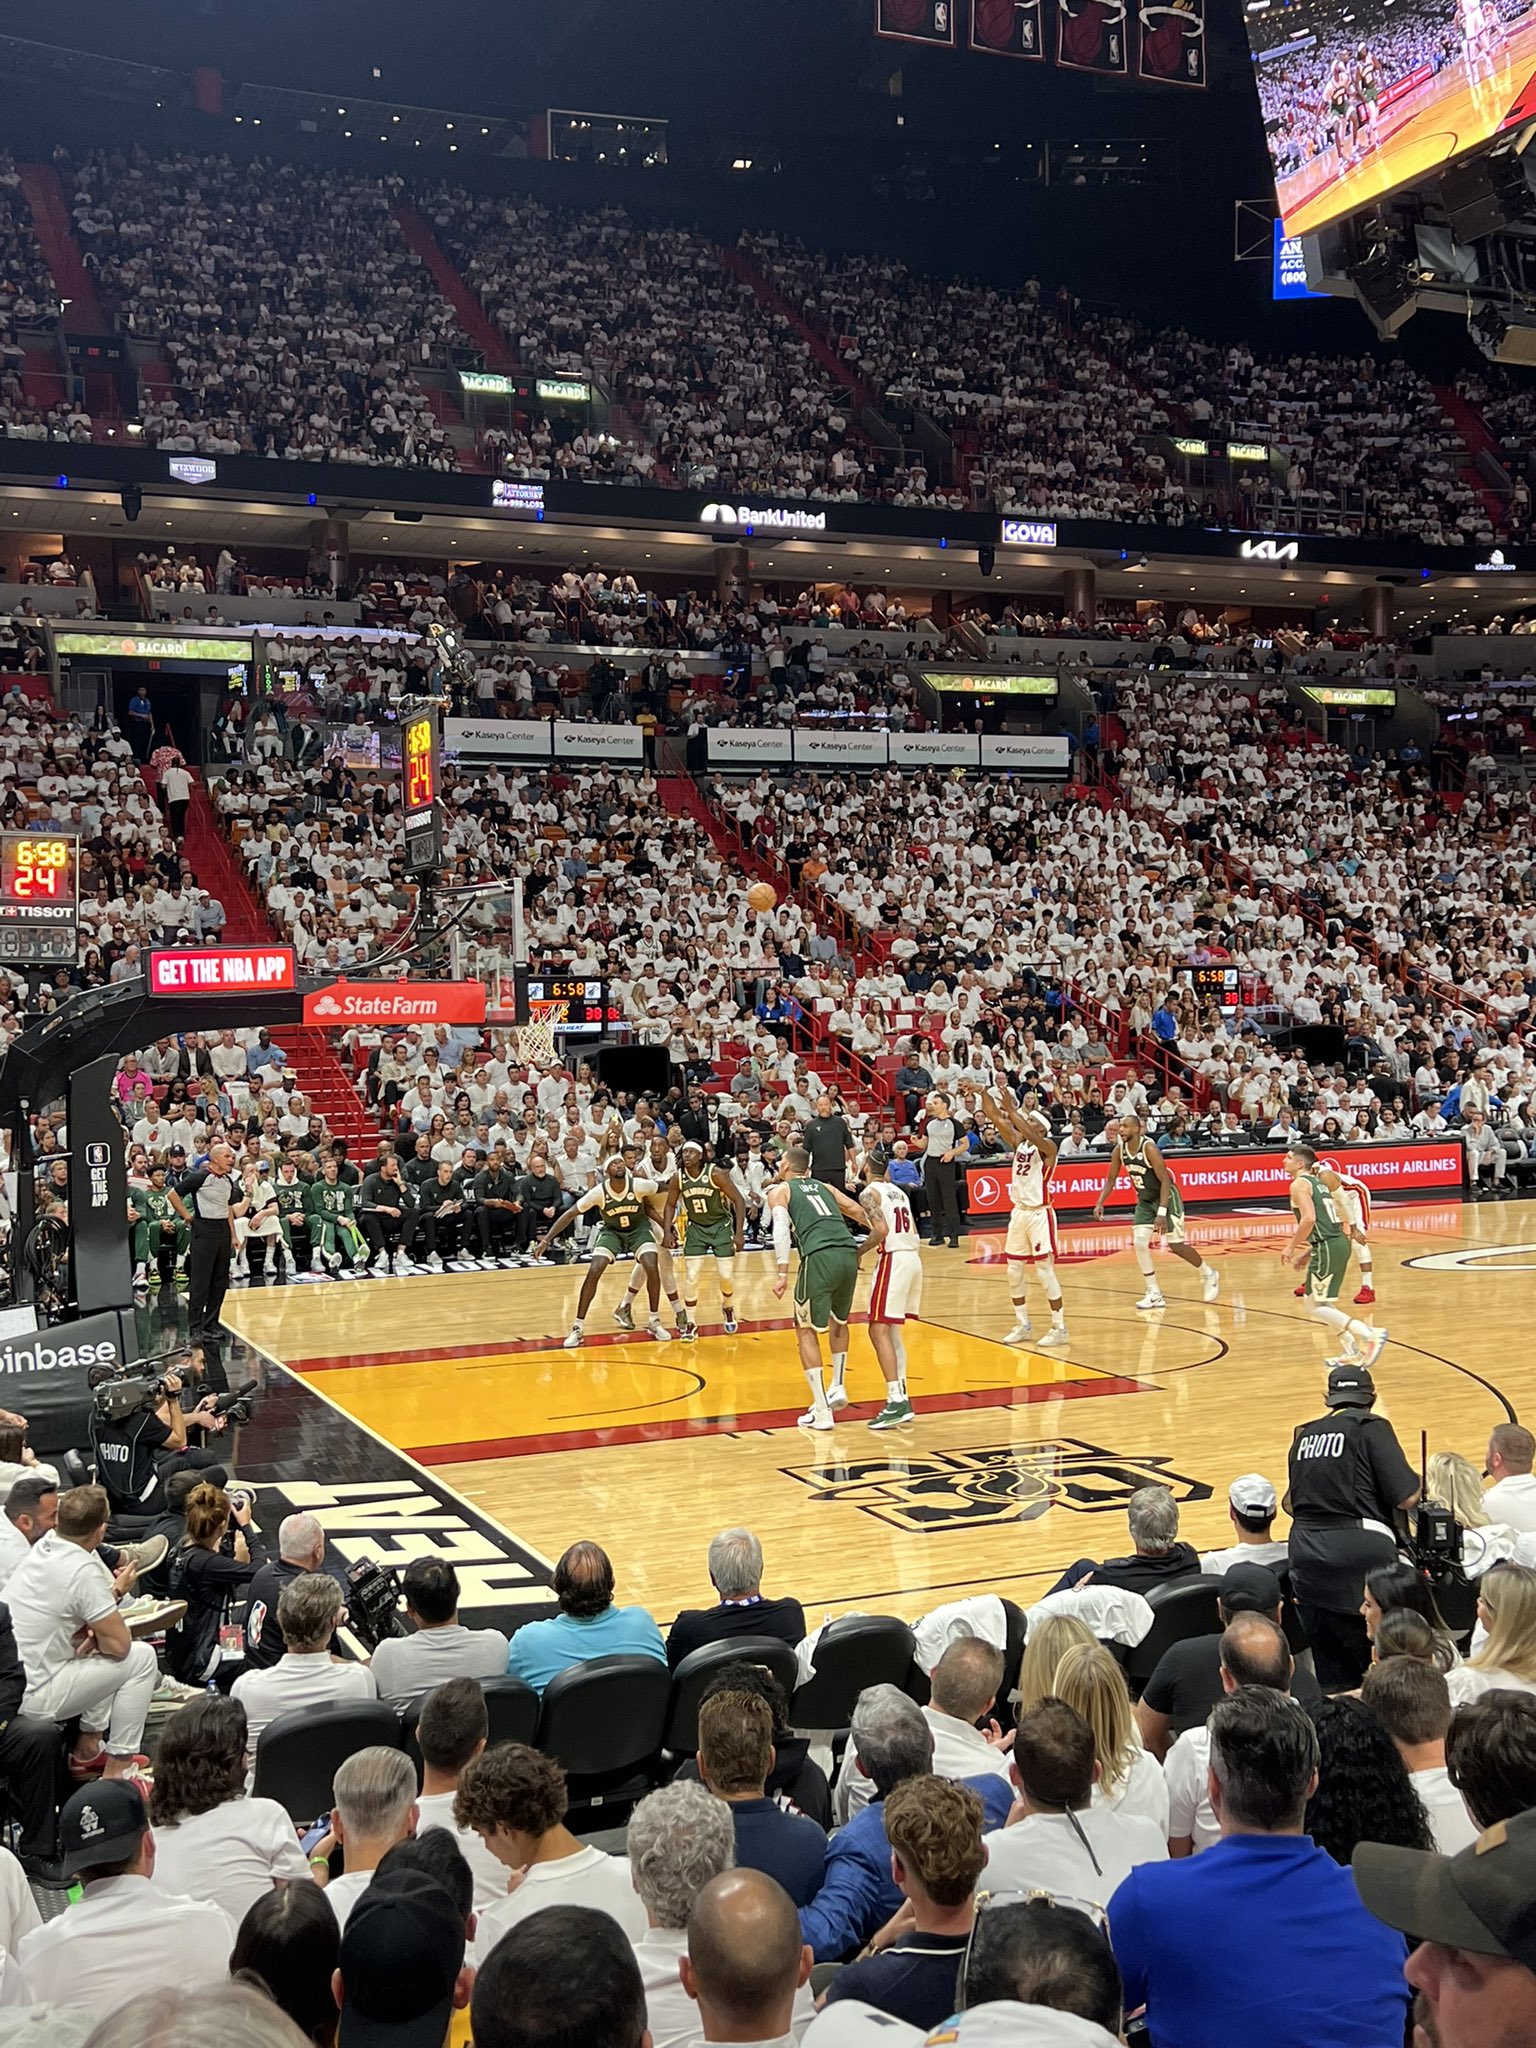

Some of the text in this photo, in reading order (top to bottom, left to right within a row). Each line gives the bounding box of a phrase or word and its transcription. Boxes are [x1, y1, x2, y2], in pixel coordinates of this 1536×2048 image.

[1280, 241, 1303, 255] AN
[1280, 259, 1305, 270] ACC
[540, 384, 587, 400] BACARDÍ
[738, 506, 826, 529] BankUnited
[1006, 523, 1054, 542] GOYA
[138, 641, 188, 655] BACARDÍ
[974, 678, 1012, 690] BACARDÍ
[475, 730, 535, 741] Kaseya Center
[577, 734, 635, 745] Kaseya Center
[729, 739, 783, 749] Kaseya Center
[821, 741, 873, 751] Kaseya Center
[915, 744, 965, 753] Kaseya Center
[1006, 746, 1055, 755] Kaseya Center
[17, 841, 66, 867] 6:58
[15, 866, 56, 896] 24
[18, 906, 74, 918] TISSOT
[158, 956, 287, 985] GET THE NBA APP
[1199, 970, 1224, 983] 6:58
[552, 982, 585, 996] 6:58
[585, 1007, 602, 1020] 38
[90, 1167, 107, 1181] GET
[1016, 1164, 1031, 1176] 22
[1346, 1158, 1457, 1176] TURKISH AIRLINES
[1181, 1166, 1294, 1187] TURKISH AIRLINE
[91, 1181, 108, 1194] THE
[1070, 1175, 1132, 1193] AIRLIES
[91, 1194, 109, 1207] APP
[692, 1198, 708, 1213] 21
[806, 1195, 833, 1216] 11
[894, 1206, 911, 1233] 16
[0, 1341, 117, 1375] inbase
[1297, 1432, 1345, 1461] PHOTO
